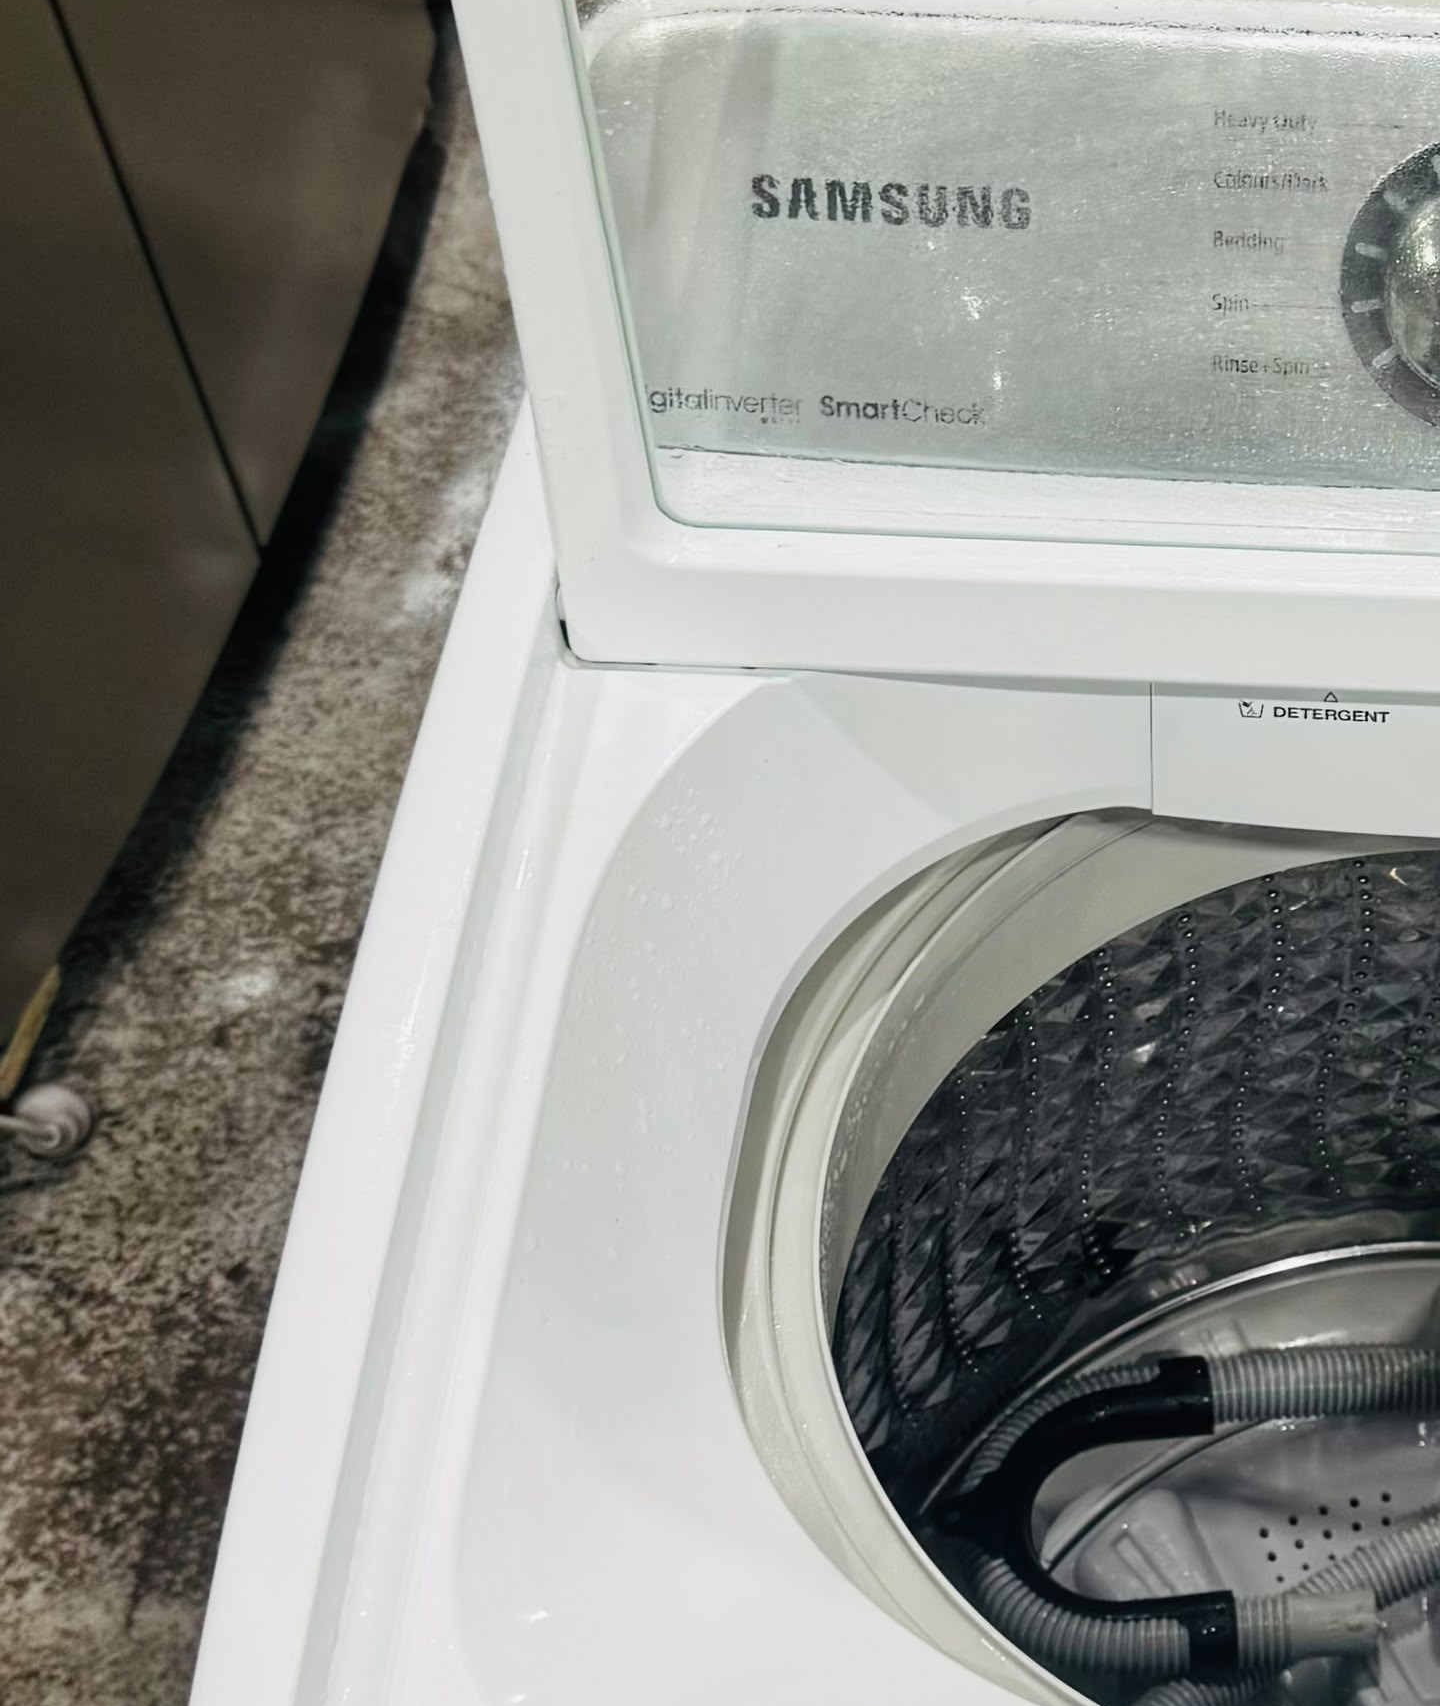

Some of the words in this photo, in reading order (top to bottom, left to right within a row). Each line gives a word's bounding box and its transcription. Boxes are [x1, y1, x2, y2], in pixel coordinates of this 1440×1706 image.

[750, 173, 1032, 230] SAMSUNG
[1212, 293, 1250, 316] Spin
[645, 387, 803, 416] gitalinverter
[1272, 705, 1390, 724] DETERGENT
